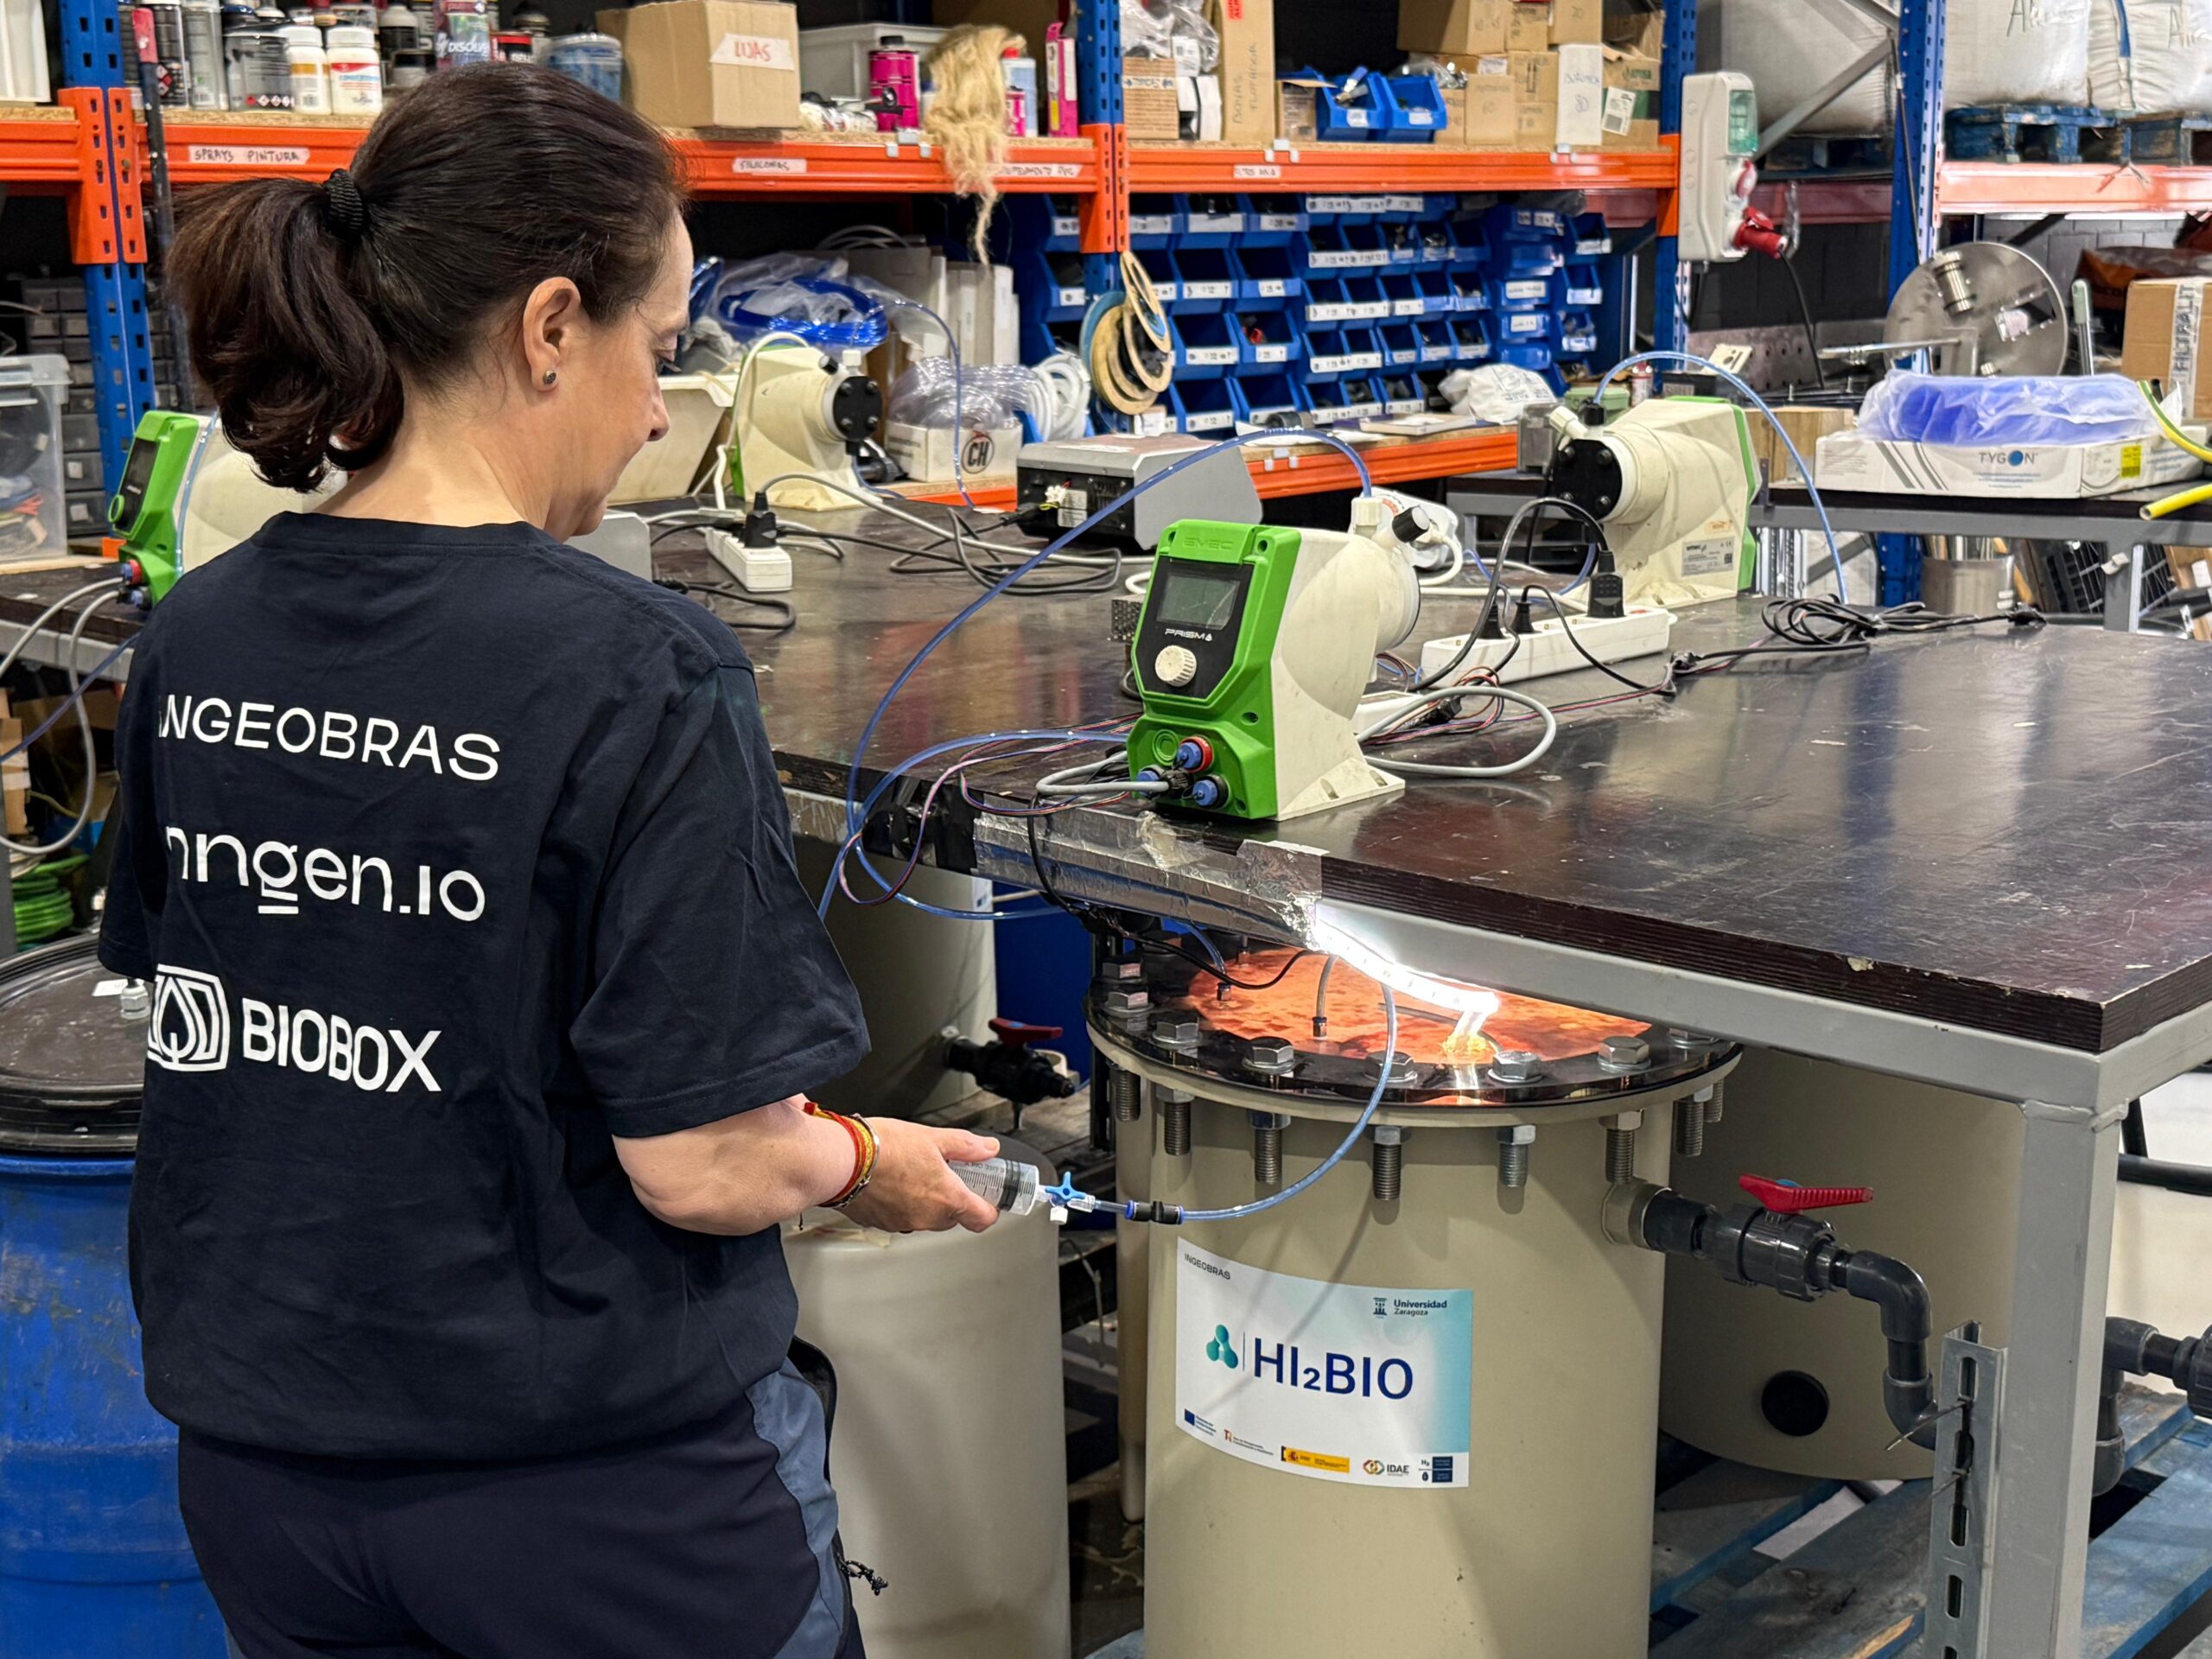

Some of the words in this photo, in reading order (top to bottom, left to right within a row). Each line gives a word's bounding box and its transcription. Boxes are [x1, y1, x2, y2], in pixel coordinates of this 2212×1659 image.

[194, 148, 234, 162] SPRAYS
[247, 149, 301, 163] PINTURA
[967, 441, 990, 467] CH
[242, 997, 442, 1093] BIOBOX
[1184, 1252, 1231, 1281] INGEOBRAS
[1393, 1299, 1447, 1309] Universidad
[1394, 1308, 1429, 1317] Zaragoza
[1386, 1464, 1410, 1474] IDAE
